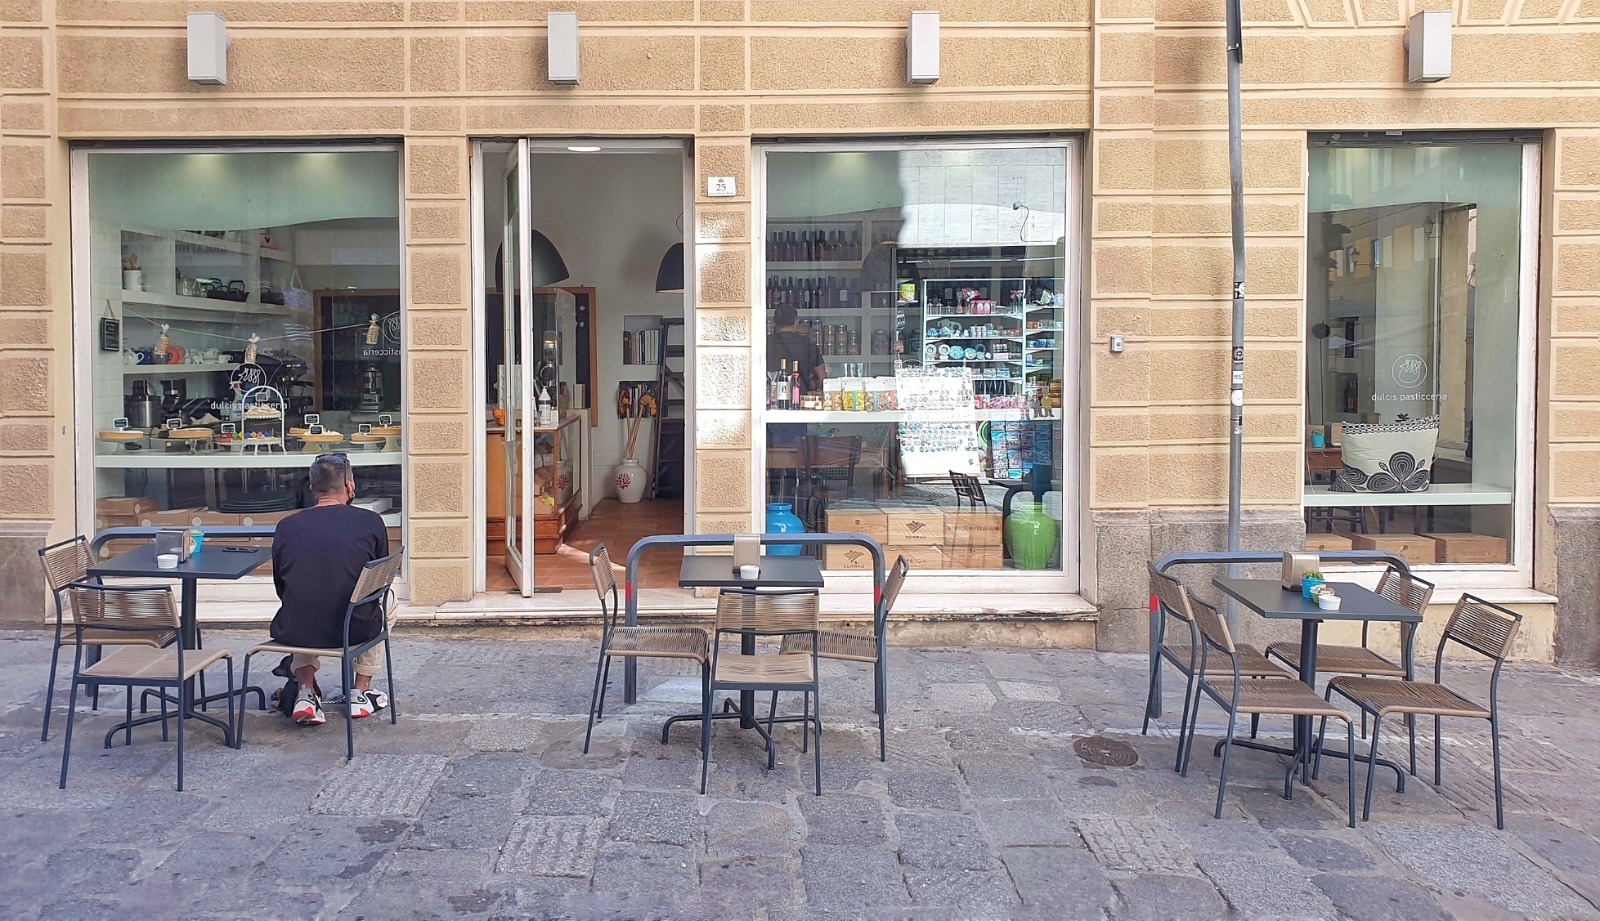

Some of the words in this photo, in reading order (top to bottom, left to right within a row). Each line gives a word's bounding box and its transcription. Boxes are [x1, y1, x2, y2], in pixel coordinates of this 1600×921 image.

[716, 183, 726, 191] 25
[1371, 392, 1397, 401] dulcis
[1399, 391, 1448, 403] pasticceria
